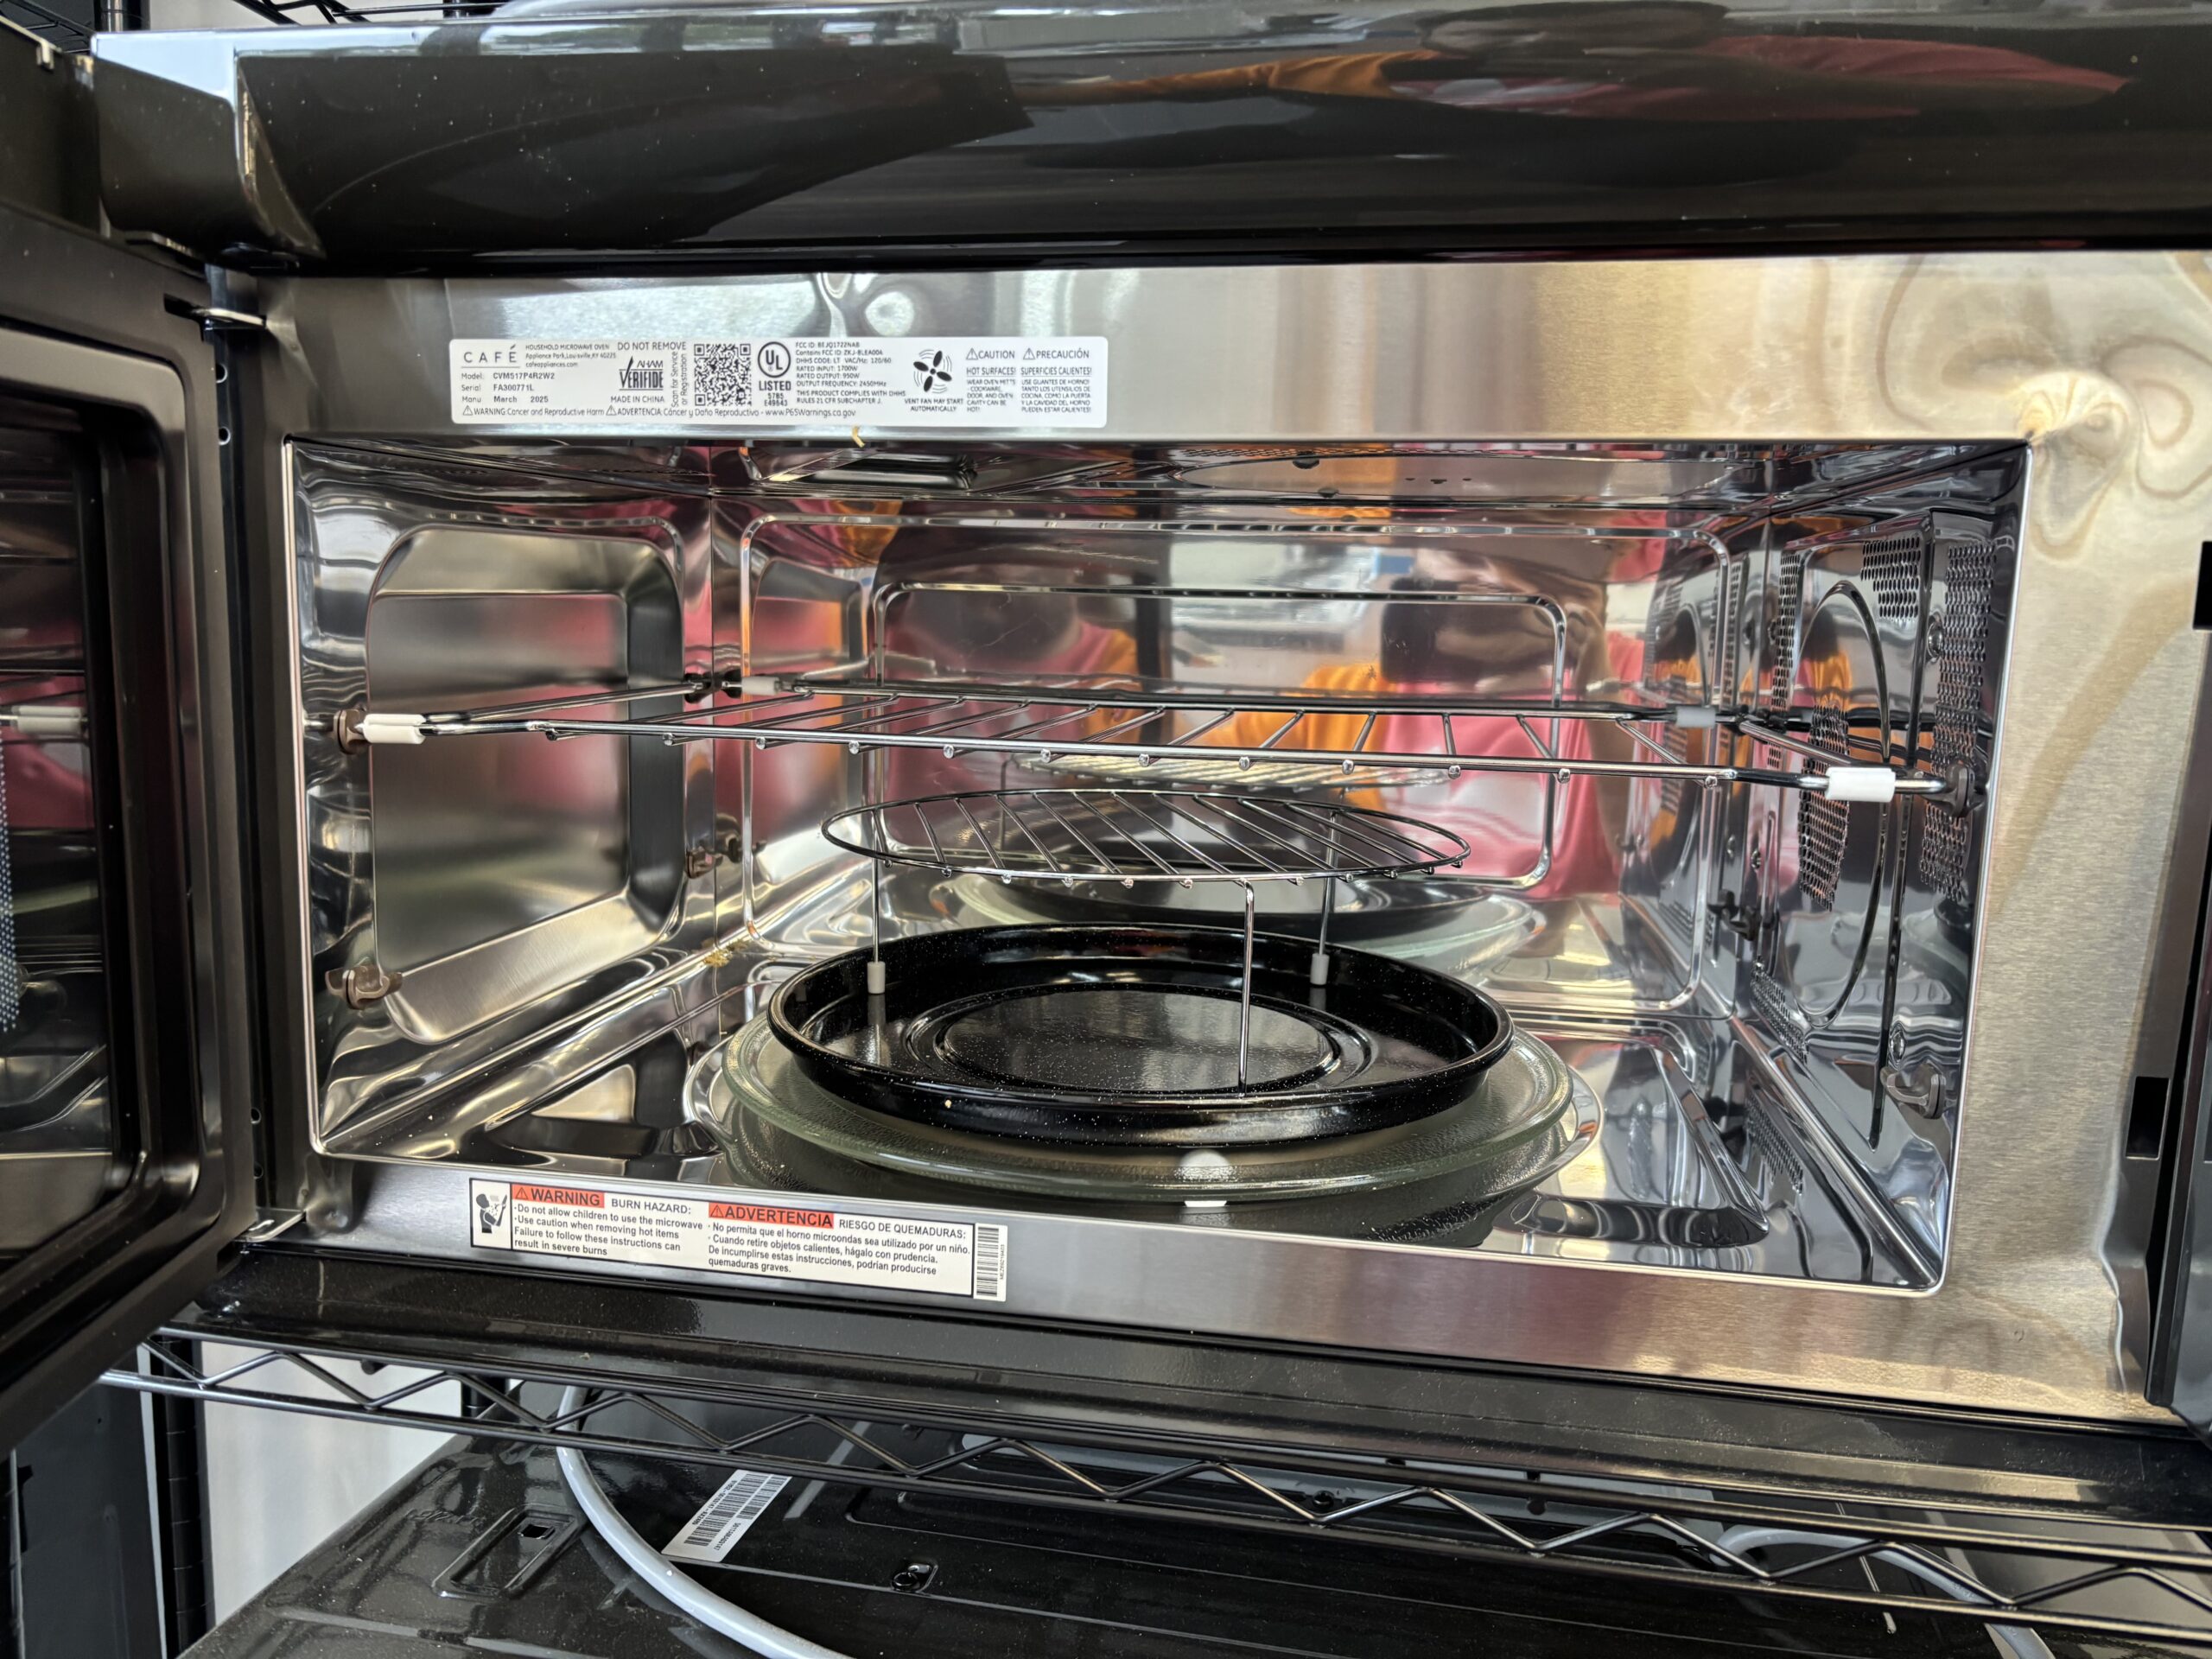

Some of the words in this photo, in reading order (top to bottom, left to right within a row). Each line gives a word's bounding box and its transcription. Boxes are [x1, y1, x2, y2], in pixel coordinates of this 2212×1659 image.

[463, 344, 517, 363] CAFÉ
[618, 341, 630, 351] DO
[632, 341, 650, 351] NOT
[652, 341, 687, 351] REMOVE
[978, 350, 1015, 359] CAUTION
[1036, 347, 1090, 359] PRECAUCIÓN
[766, 350, 784, 371] UL
[619, 355, 664, 389] VERIFIDE
[680, 354, 689, 396] Registration
[759, 380, 791, 391] LISTED
[544, 408, 584, 417] Reproductive
[715, 409, 760, 418] Reproductivo
[531, 1188, 601, 1206] WARNING
[612, 1198, 641, 1210] BURN
[644, 1202, 691, 1215] HAZARD:
[531, 1206, 546, 1215] not
[548, 1207, 571, 1217] allow
[573, 1210, 607, 1220] children
[610, 1213, 619, 1222] to
[621, 1215, 637, 1224] use
[639, 1216, 653, 1225] the
[655, 1217, 703, 1230] microwave
[724, 1205, 833, 1227] ADVERTENCIA
[518, 1215, 534, 1224] Use
[536, 1218, 568, 1228] caution
[570, 1221, 594, 1230] when
[595, 1224, 636, 1236] removing
[639, 1226, 653, 1236] hot
[655, 1228, 679, 1239] items
[839, 1219, 875, 1231] RIESGO
[878, 1222, 891, 1232] DE
[893, 1224, 966, 1239] QUEMADURAS:
[514, 1226, 543, 1237] Failure
[556, 1230, 582, 1241] follow
[584, 1234, 608, 1244] these
[610, 1236, 662, 1249] instructions
[664, 1243, 681, 1251] can
[713, 1222, 724, 1231] No
[726, 1225, 757, 1235] permita
[760, 1228, 775, 1237] que
[777, 1229, 785, 1237] el
[786, 1229, 811, 1240] horno
[813, 1232, 862, 1244] microondas
[864, 1237, 880, 1246] sea
[881, 1238, 917, 1249] utilizado
[918, 1243, 933, 1252] por
[514, 1239, 539, 1249] result
[542, 1241, 550, 1249] in
[552, 1244, 581, 1253] severe
[582, 1245, 607, 1255] burns
[713, 1234, 745, 1245] Cuando
[747, 1237, 768, 1247] retire
[770, 1240, 801, 1251] objetos
[803, 1243, 843, 1255] calientes,
[845, 1246, 873, 1258] hágalo
[874, 1250, 891, 1259] con
[893, 1252, 938, 1263] prudencia.
[709, 1244, 720, 1254] De
[721, 1246, 769, 1259] incumplirse
[772, 1253, 793, 1262] estas
[796, 1253, 855, 1268] instrucciones,
[891, 1262, 937, 1275] producirse
[709, 1257, 759, 1269] quemaduras
[761, 1262, 791, 1272] graves.
